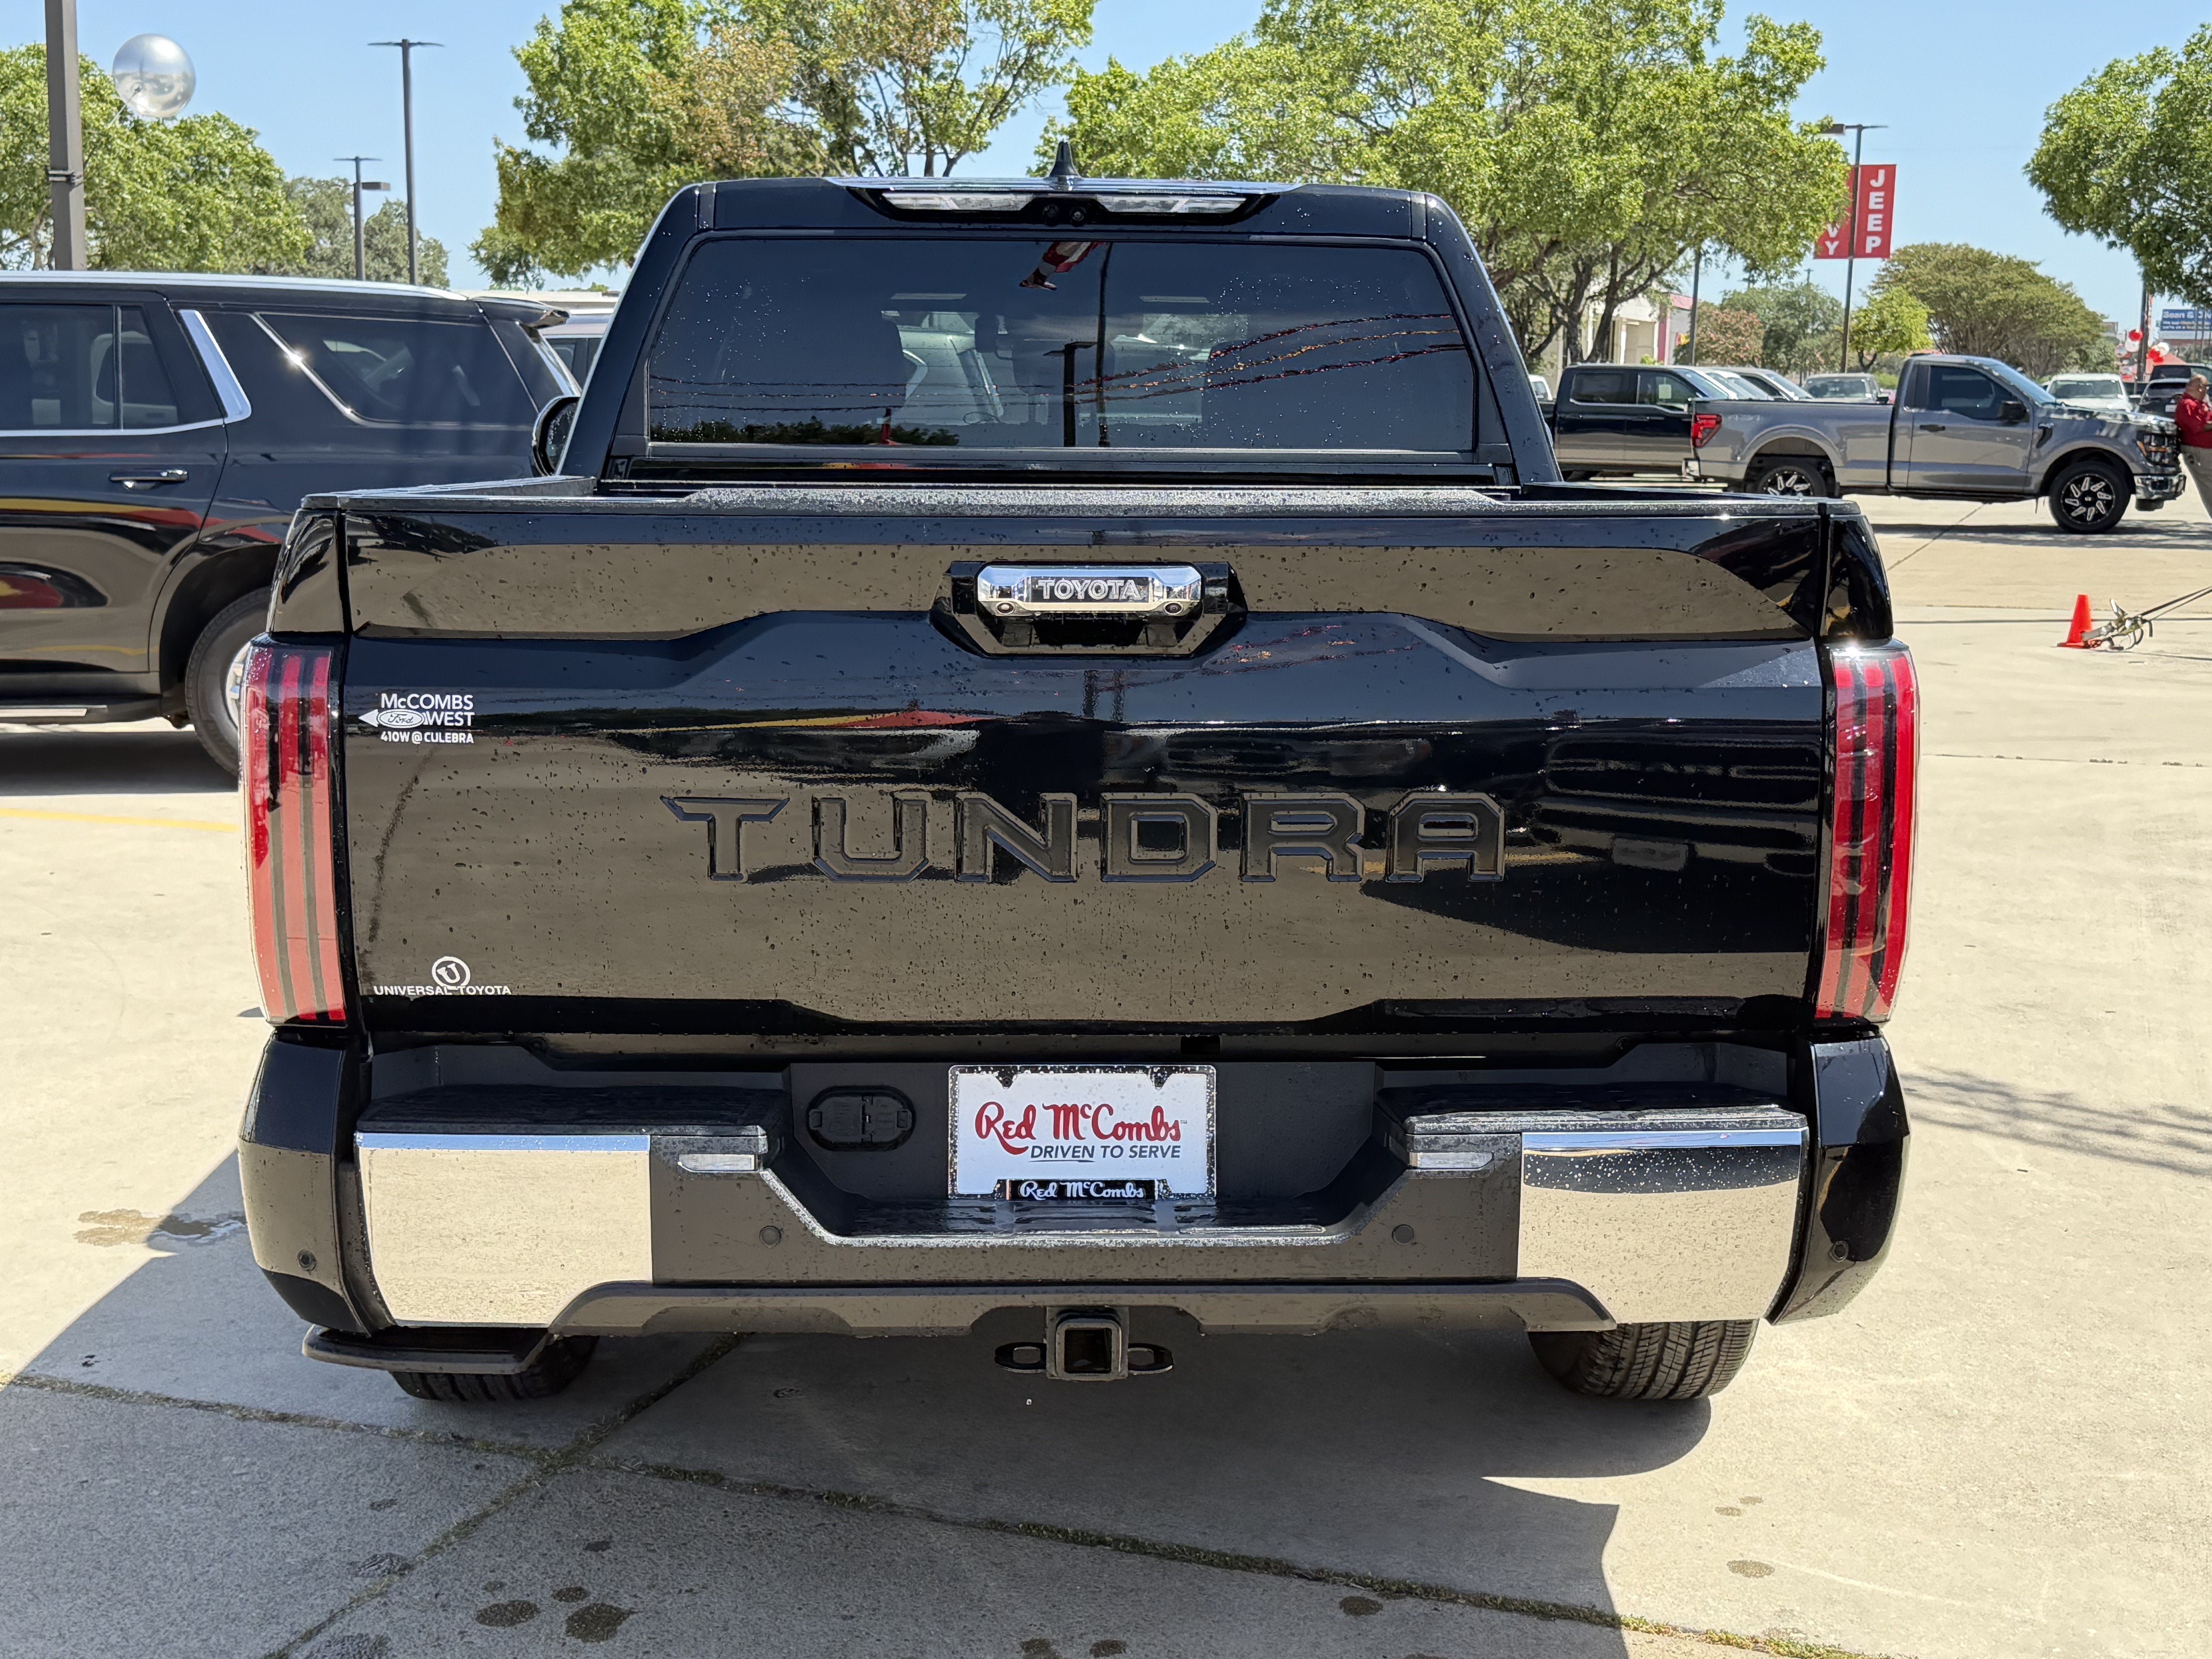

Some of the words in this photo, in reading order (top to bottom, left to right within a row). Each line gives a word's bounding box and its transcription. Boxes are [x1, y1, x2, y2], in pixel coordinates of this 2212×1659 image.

[1865, 169, 1885, 253] JEEP
[1038, 579, 1140, 600] TOYOTA
[381, 693, 474, 710] McCOMBS
[388, 713, 414, 724] Ford
[426, 711, 475, 726] WEST
[424, 732, 474, 744] CULEBRA
[659, 791, 1506, 884] TUNDRA
[373, 986, 452, 995] UNIVERSAL
[458, 986, 512, 995] TOYOTA
[975, 1101, 1036, 1155] Red
[1042, 1103, 1181, 1141] McCombs
[1030, 1145, 1095, 1159] DRIVEN
[1101, 1145, 1124, 1159] TO
[1128, 1145, 1181, 1159] SERVE
[1020, 1181, 1058, 1200] Red
[1060, 1182, 1144, 1198] McCombs
